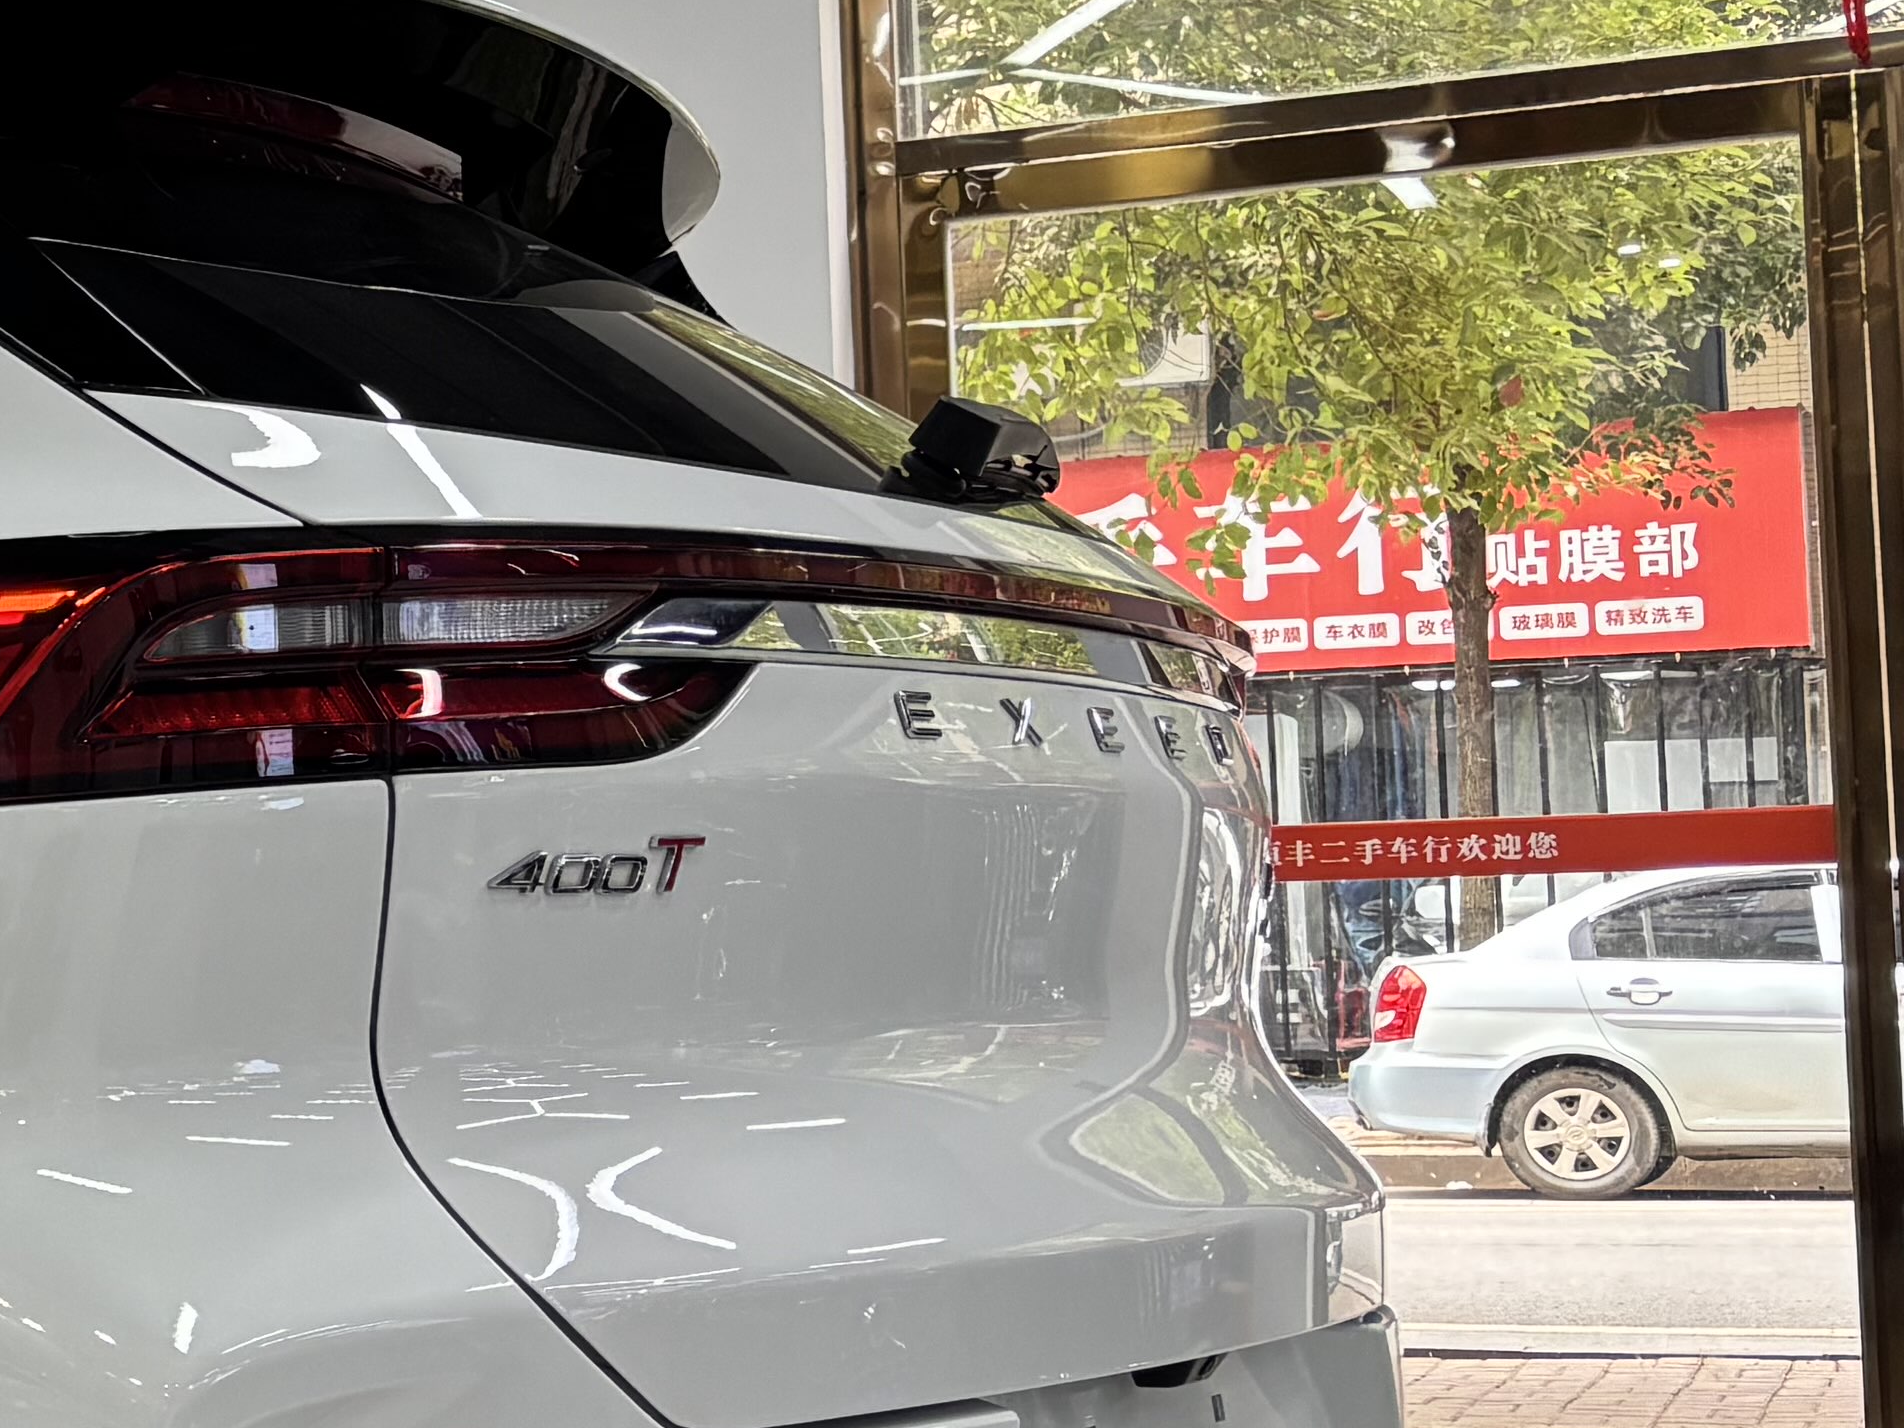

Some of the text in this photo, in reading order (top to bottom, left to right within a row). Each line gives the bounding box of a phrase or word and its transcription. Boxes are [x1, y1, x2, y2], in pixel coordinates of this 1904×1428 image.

[1511, 610, 1578, 631] 玻璃膜
[1605, 605, 1695, 627] 精致洗车
[1326, 622, 1388, 641] 车衣膜
[487, 834, 706, 896] 400T
